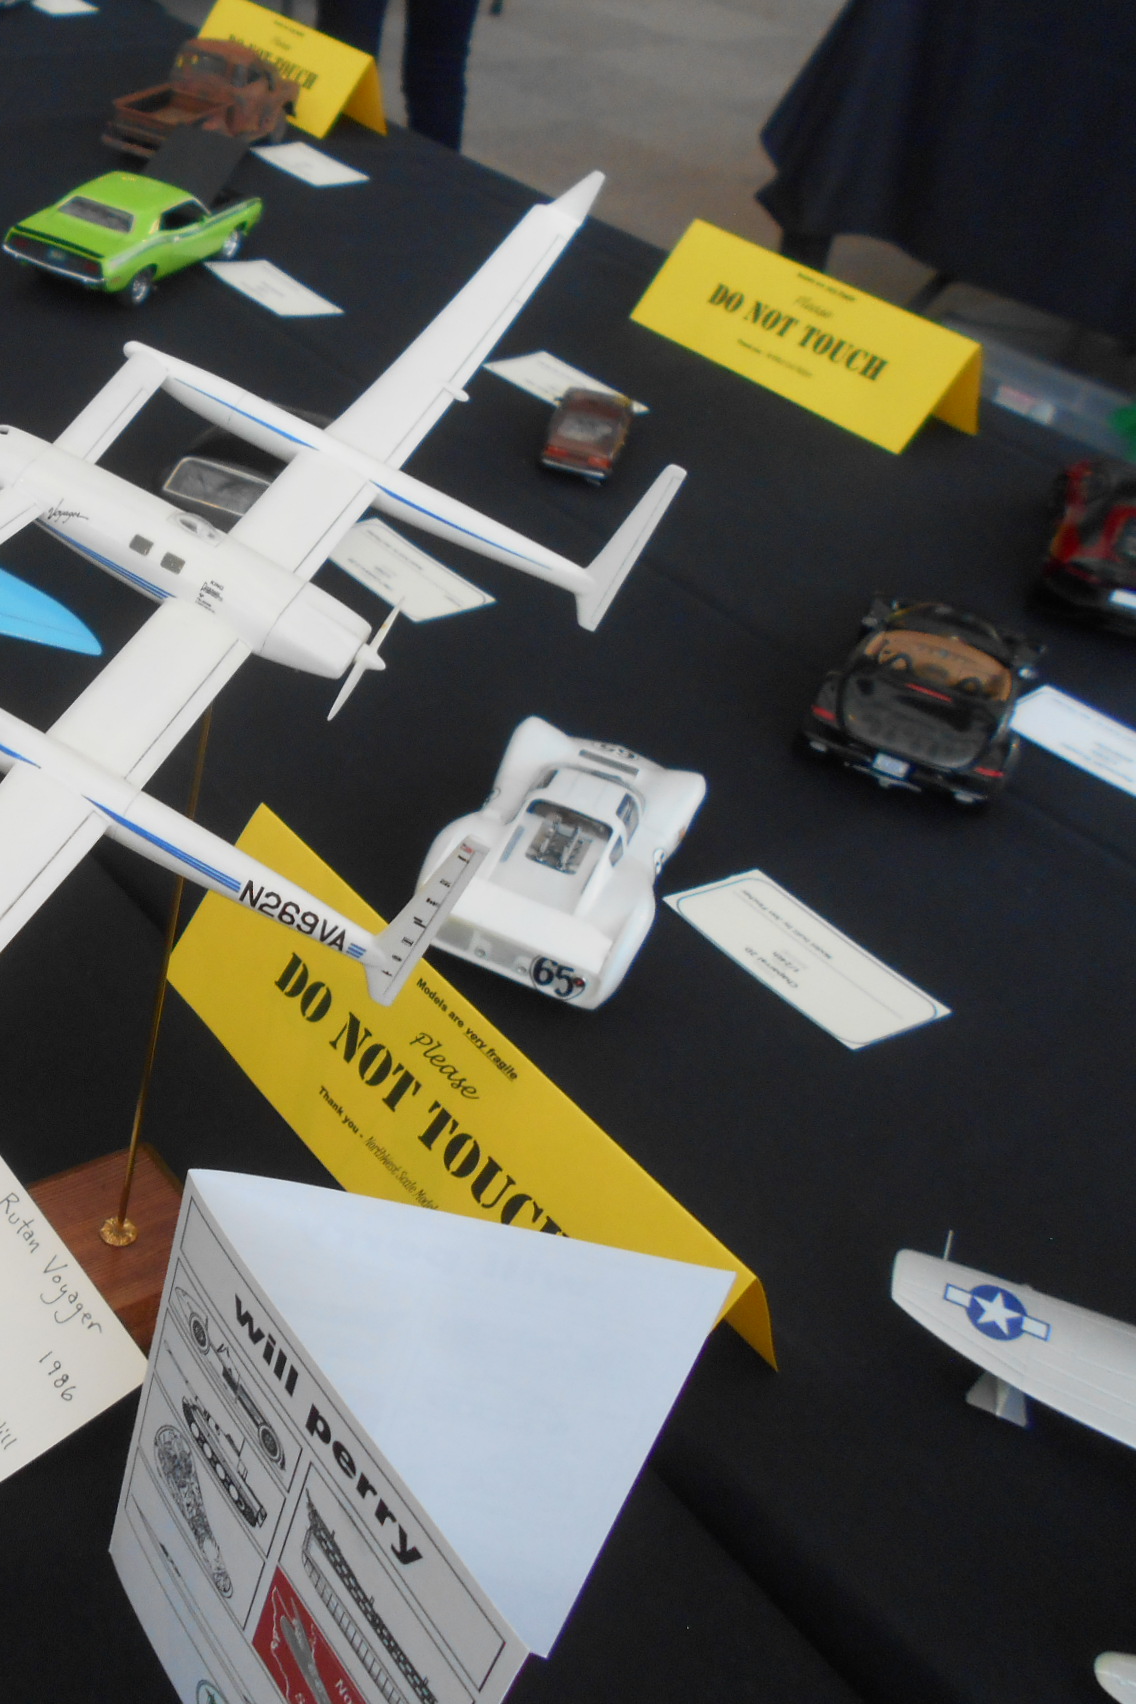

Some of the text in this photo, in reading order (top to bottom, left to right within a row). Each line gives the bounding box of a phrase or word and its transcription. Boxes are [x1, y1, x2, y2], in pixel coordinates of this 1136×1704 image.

[708, 283, 745, 313] DO
[743, 300, 799, 337] NOT
[798, 324, 888, 381] TOUCH
[239, 880, 346, 951] N269VA
[532, 956, 575, 998] 65
[274, 952, 332, 1023] DO
[329, 1012, 422, 1112] NOT
[410, 1032, 480, 1099] Please
[417, 978, 518, 1080] Models are very fragile
[318, 1085, 344, 1117] Thank
[342, 1115, 360, 1134] you
[40, 1254, 102, 1334] Voyager
[39, 1351, 76, 1402] 1986
[235, 1293, 423, 1565] will perry
